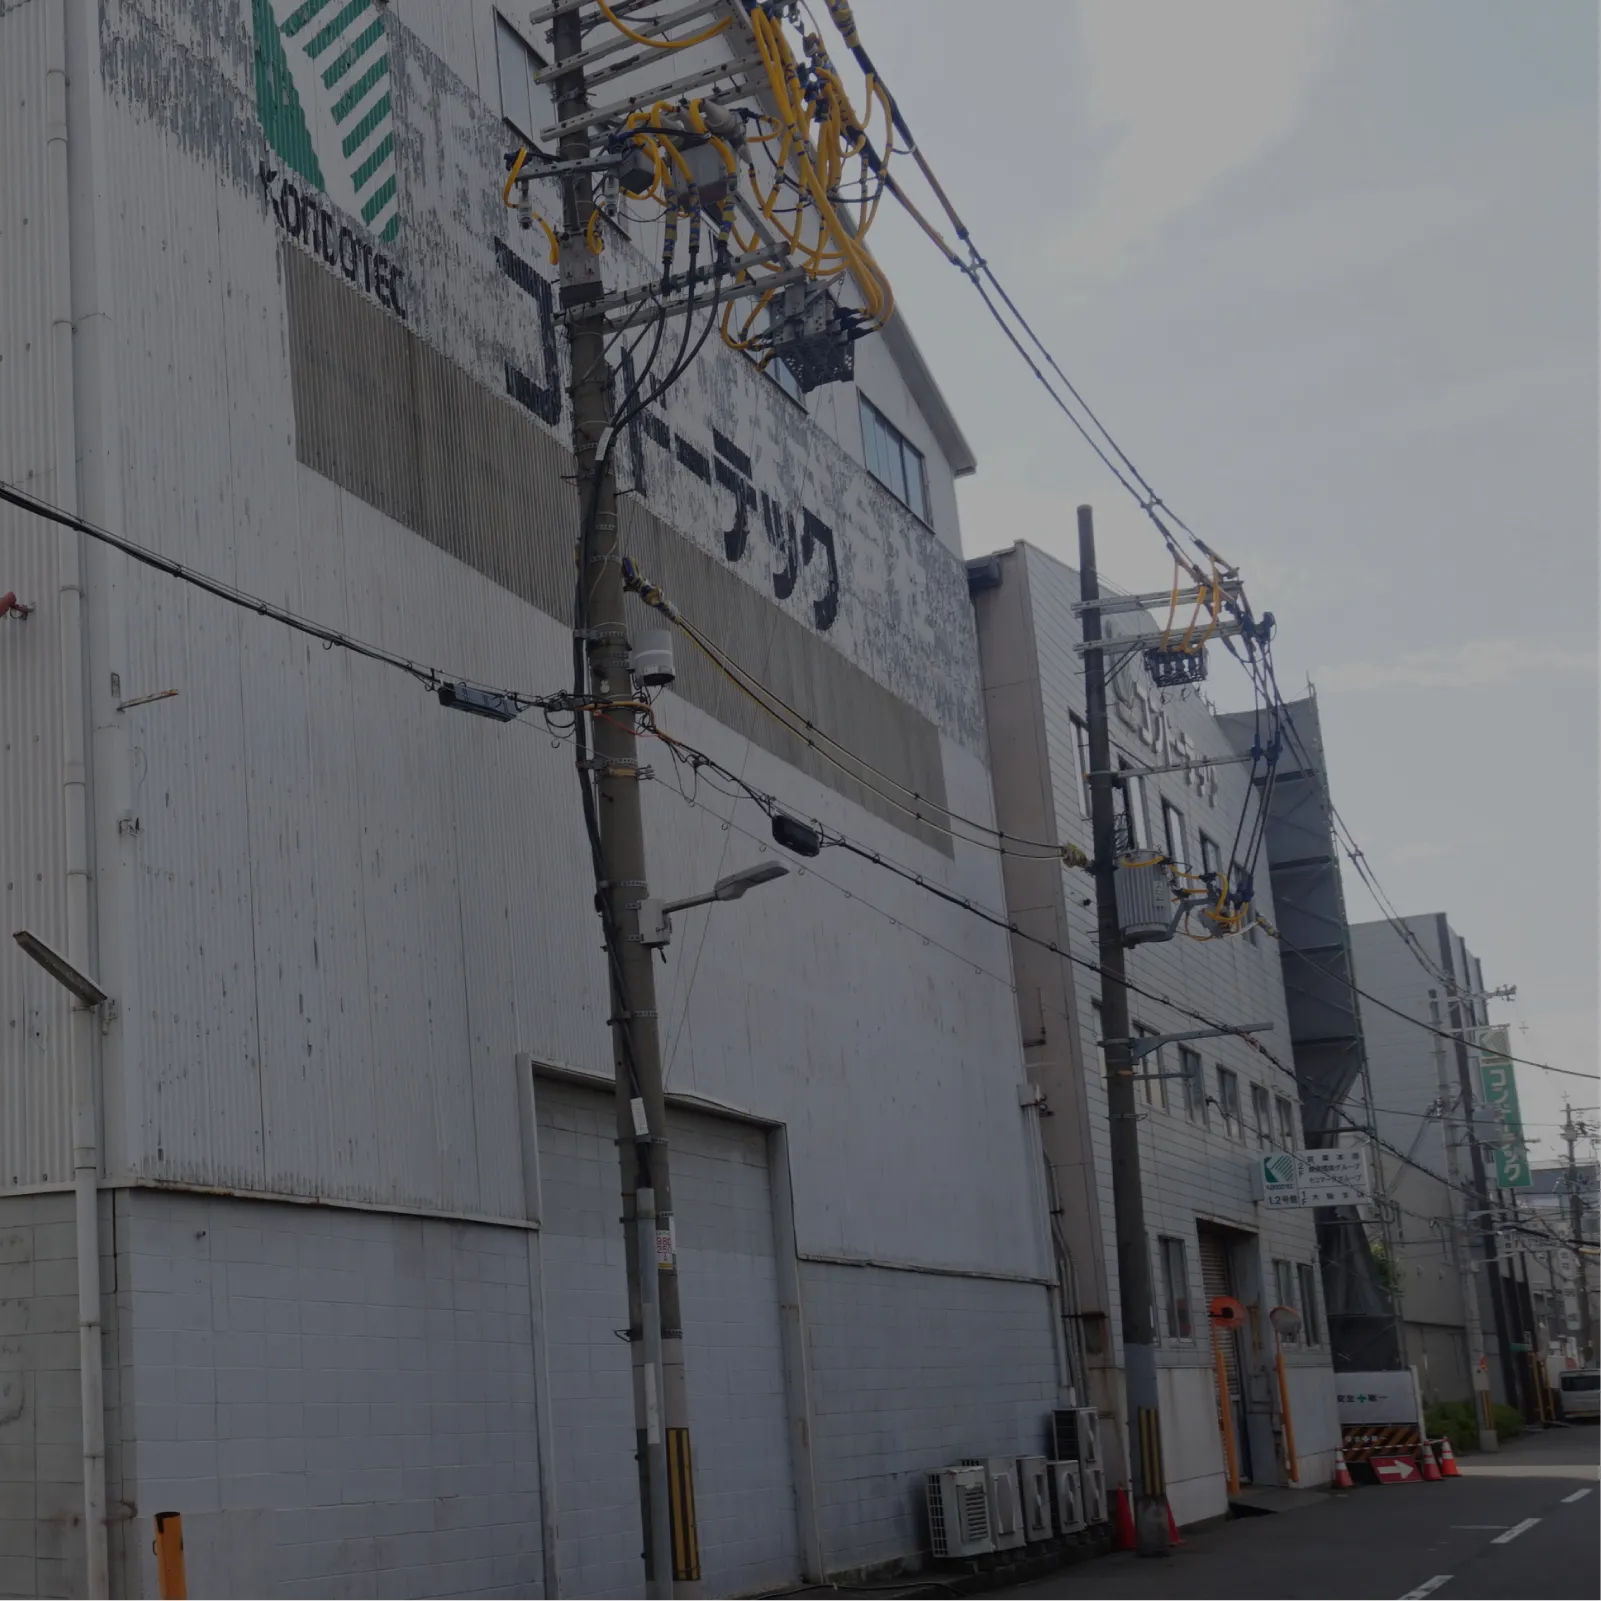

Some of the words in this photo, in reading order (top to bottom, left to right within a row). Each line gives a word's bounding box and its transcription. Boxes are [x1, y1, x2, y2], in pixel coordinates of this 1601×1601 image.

[259, 161, 406, 320] KONDOTEC
[494, 235, 843, 632] コドーテック
